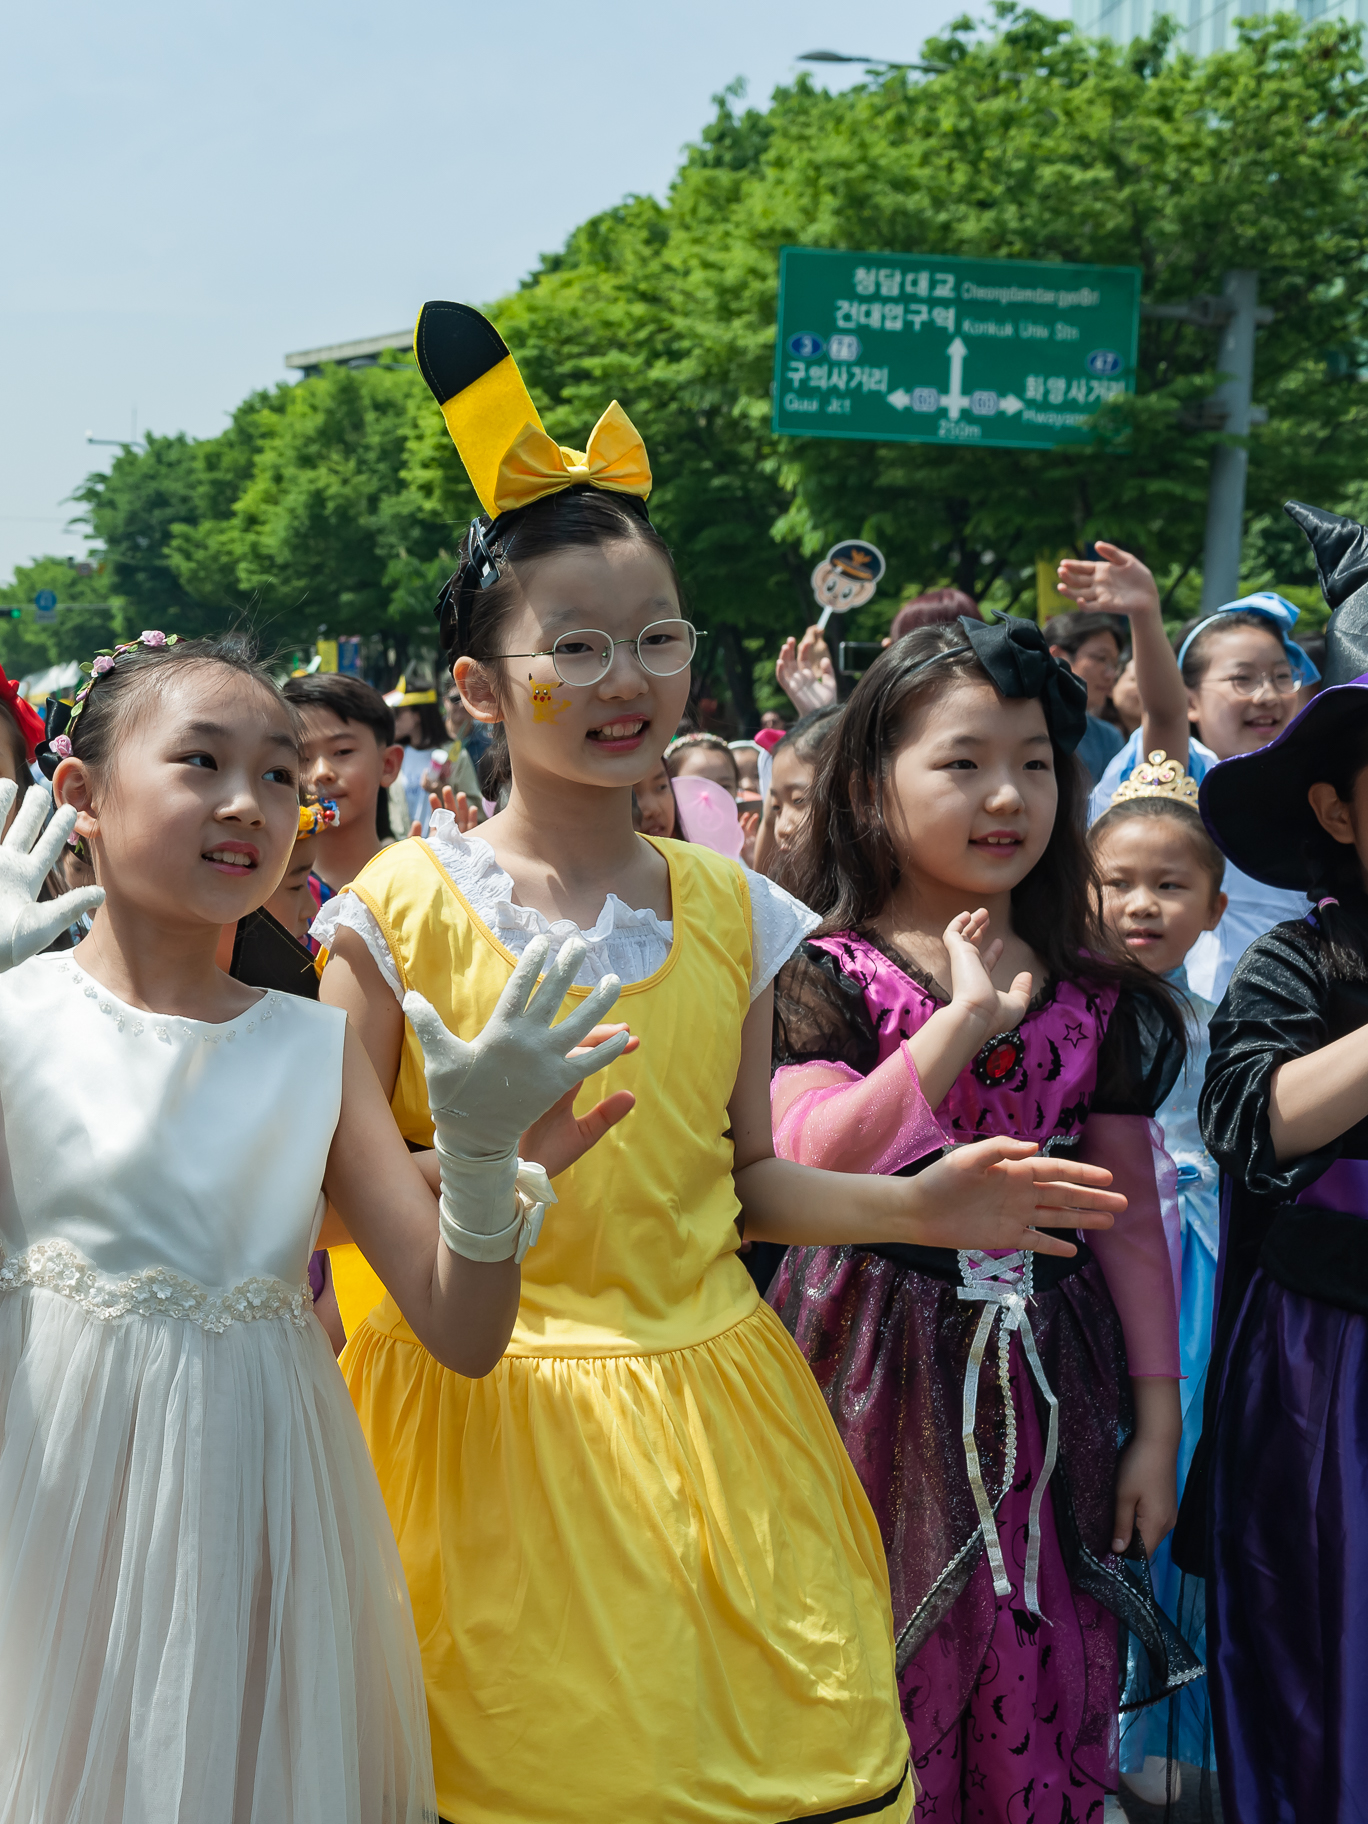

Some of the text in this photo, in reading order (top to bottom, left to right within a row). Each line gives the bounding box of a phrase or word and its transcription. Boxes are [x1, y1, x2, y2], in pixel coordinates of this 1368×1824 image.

[852, 266, 957, 299] 청담대교
[835, 300, 957, 333] 건대입구역
[961, 318, 1014, 339] Konkuk
[786, 361, 889, 394] 구의사거리
